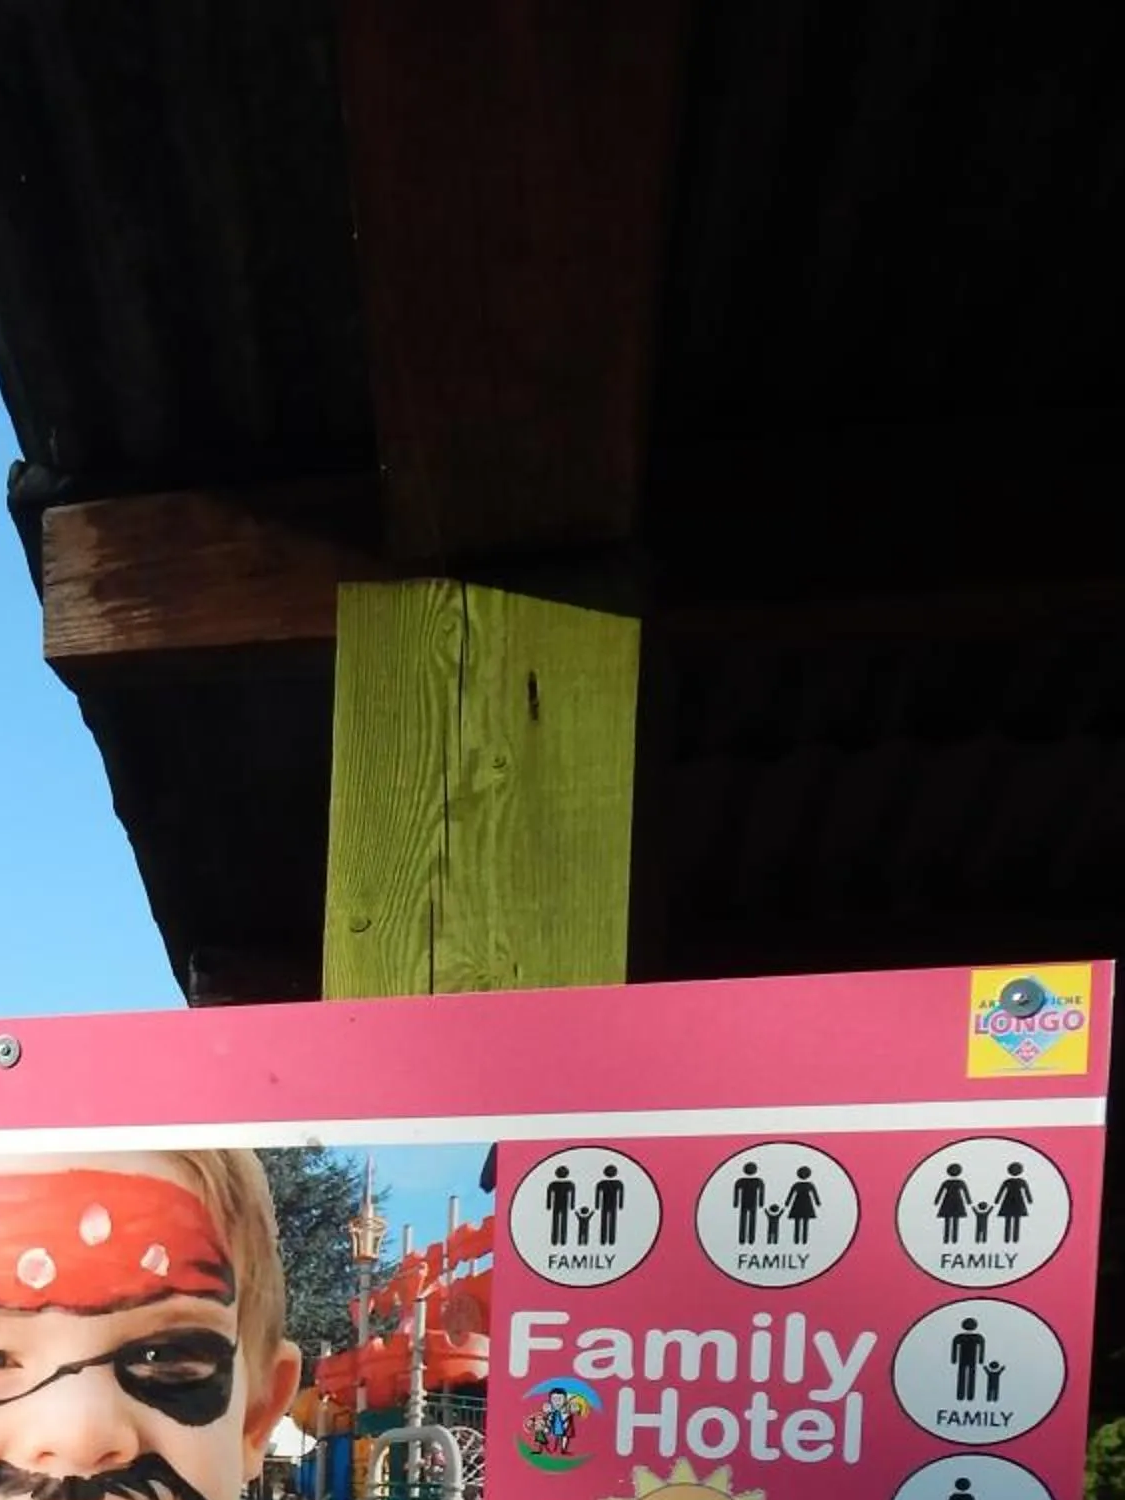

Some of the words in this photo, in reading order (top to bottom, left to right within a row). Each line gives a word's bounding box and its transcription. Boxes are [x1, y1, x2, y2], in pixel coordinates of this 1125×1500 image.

[974, 1009, 1085, 1034] LONGO
[548, 1254, 616, 1269] FAMILY
[737, 1253, 810, 1269] FAMILY
[940, 1252, 1017, 1269] FAMILY
[509, 1311, 877, 1402] Family
[616, 1387, 863, 1463] Hotel
[936, 1408, 1014, 1427] FAMILY
